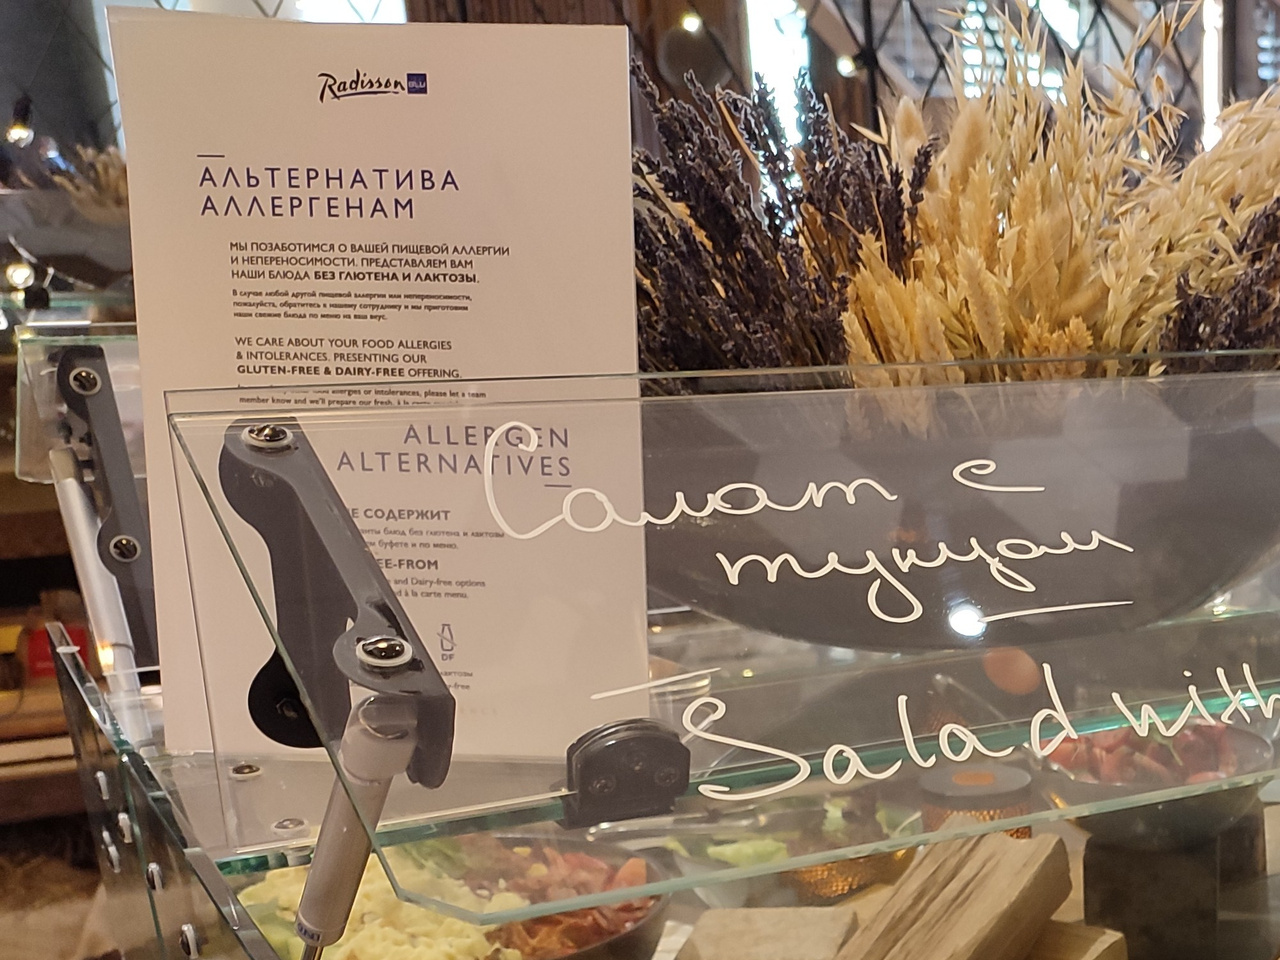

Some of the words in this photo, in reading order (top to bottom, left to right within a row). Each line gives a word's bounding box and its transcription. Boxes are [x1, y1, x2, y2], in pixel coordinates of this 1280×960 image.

[318, 68, 406, 104] Radisson
[199, 166, 459, 191] АЛЬТЕРНАТИВА
[201, 195, 414, 219] АЛЛЕРГЕНАМ
[230, 242, 247, 251] МЫ
[250, 242, 335, 253] ПОЗАБОТИМСЯ
[338, 243, 347, 253] О
[351, 242, 388, 254] ВАШЕЙ
[392, 243, 449, 256] ПИЩЕВОЙ
[452, 246, 510, 256] АЛЛЕРГИИ
[230, 256, 239, 265] И
[242, 256, 358, 267] НЕПЕРЕНОСИМОСТИ.
[361, 258, 447, 269] ПРЕДСТАВЛЯЕМ
[450, 259, 473, 269] ВАМ
[231, 270, 265, 280] НАШИ
[268, 270, 310, 281] БЛЮДА
[314, 271, 336, 281] БЕЗ
[339, 271, 399, 282] ГЛЮТЕНА
[402, 272, 411, 282] И
[414, 273, 480, 283] ЛАКТОЗЫ.
[235, 337, 252, 346] WE
[256, 337, 284, 347] CARE
[287, 338, 325, 348] ABOUT
[328, 338, 358, 348] YOUR
[362, 339, 394, 349] FOOD
[398, 340, 452, 350] ALLERGIES
[236, 351, 243, 360] &
[246, 351, 330, 361] INTOLERANCES.
[334, 352, 399, 363] PRESENTING
[402, 354, 427, 364] OUR
[237, 365, 320, 375] GLUTEN-FREE
[324, 366, 331, 376] &
[335, 367, 405, 377] DAIRY-FREE
[408, 368, 462, 378] OFFERING.
[239, 396, 269, 404] member
[272, 396, 292, 404] know
[328, 399, 356, 407] prepare
[403, 424, 569, 448] ALLERGEN
[337, 451, 571, 476] ALTERNATIVES
[483, 421, 898, 539] Салат
[363, 508, 451, 522] СОДЕРЖИТ
[409, 528, 424, 536] без
[378, 540, 408, 549] буфете
[376, 558, 439, 570] EE-FROM
[411, 578, 452, 588] Dairy-free
[455, 579, 485, 588] options
[441, 653, 455, 661] DF
[681, 662, 1079, 801] Salad
